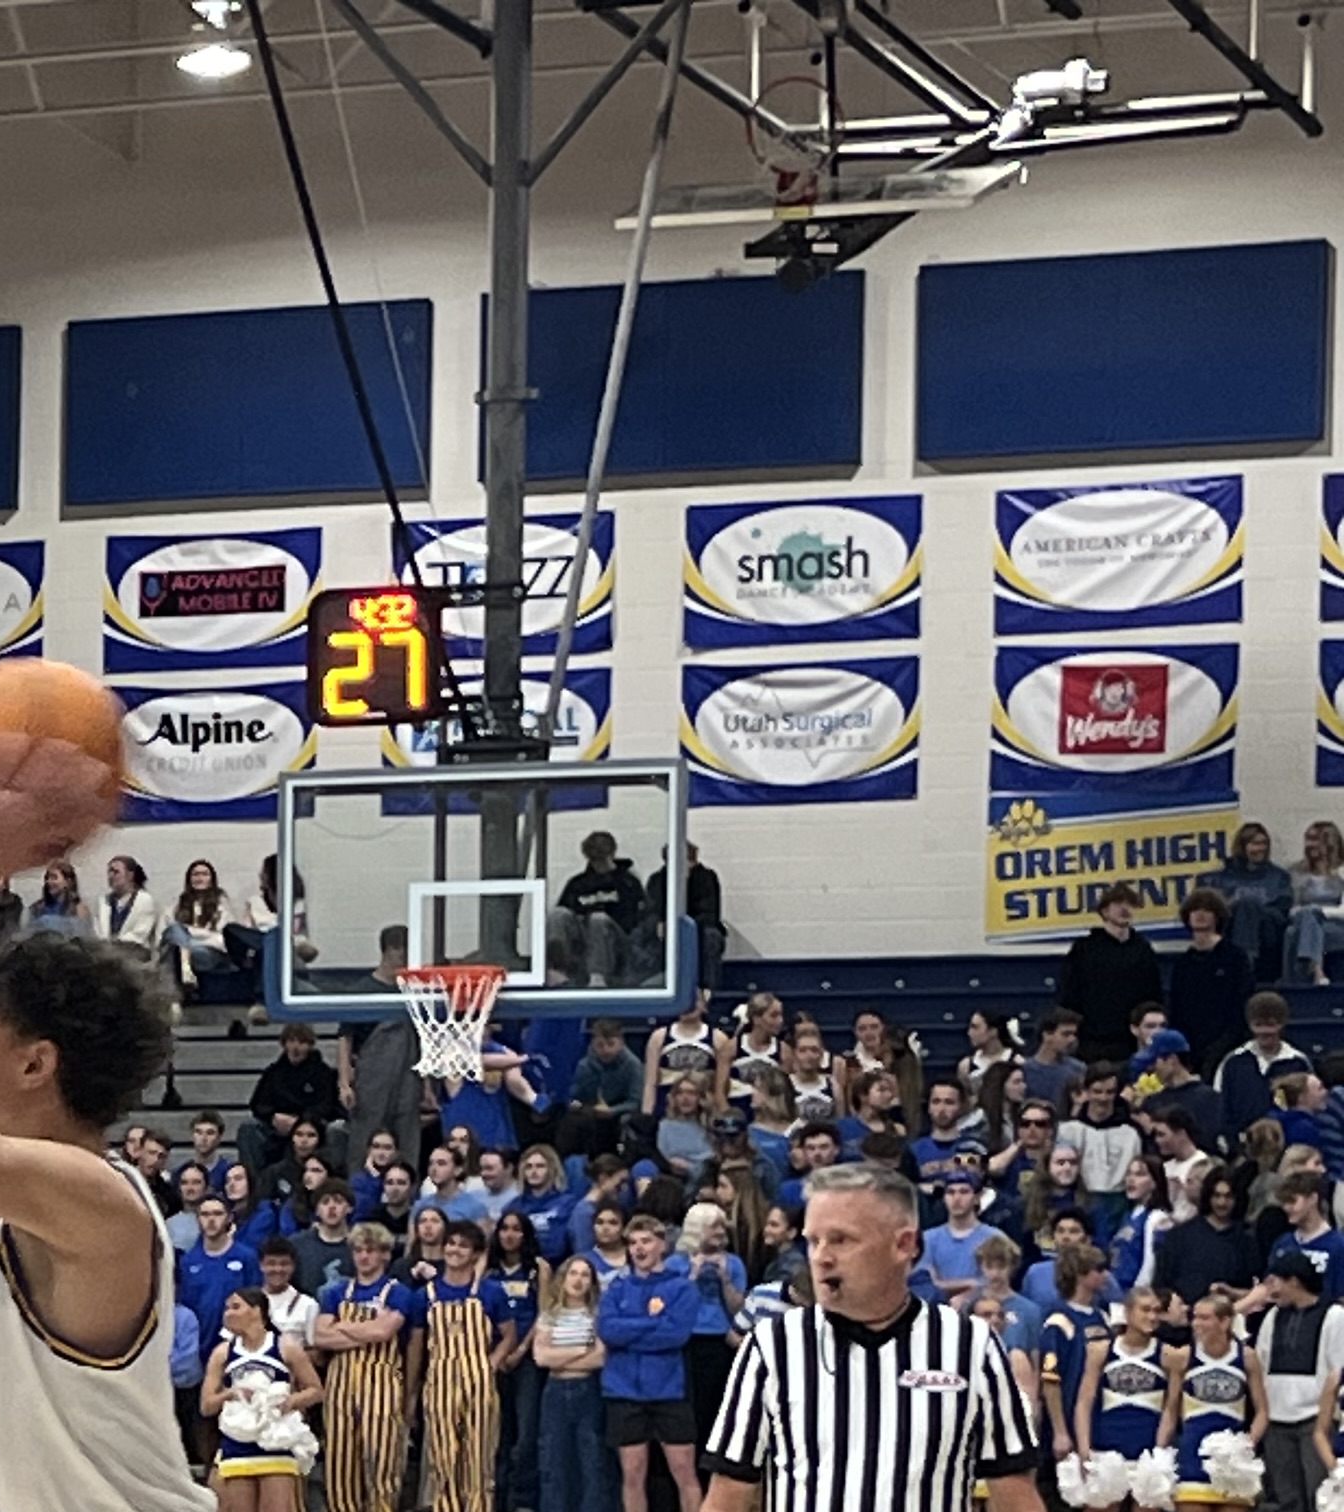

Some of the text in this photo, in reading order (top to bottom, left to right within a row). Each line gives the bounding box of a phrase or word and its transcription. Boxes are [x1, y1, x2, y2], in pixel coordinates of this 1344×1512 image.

[737, 535, 870, 583] smash
[1020, 537, 1130, 554] AMERICAN
[171, 569, 286, 591] ADVANCED
[177, 590, 278, 613] MOBILE IV
[322, 627, 427, 717] 27
[137, 713, 274, 753] Alpine
[722, 707, 873, 735] Utah Surgical
[1065, 708, 1159, 750] Wendy's
[729, 736, 874, 750] ASSOCIATES
[146, 752, 267, 774] CREDIT UNION
[995, 830, 1227, 881] OREM HIGH
[1003, 873, 1224, 922] STUDNT
